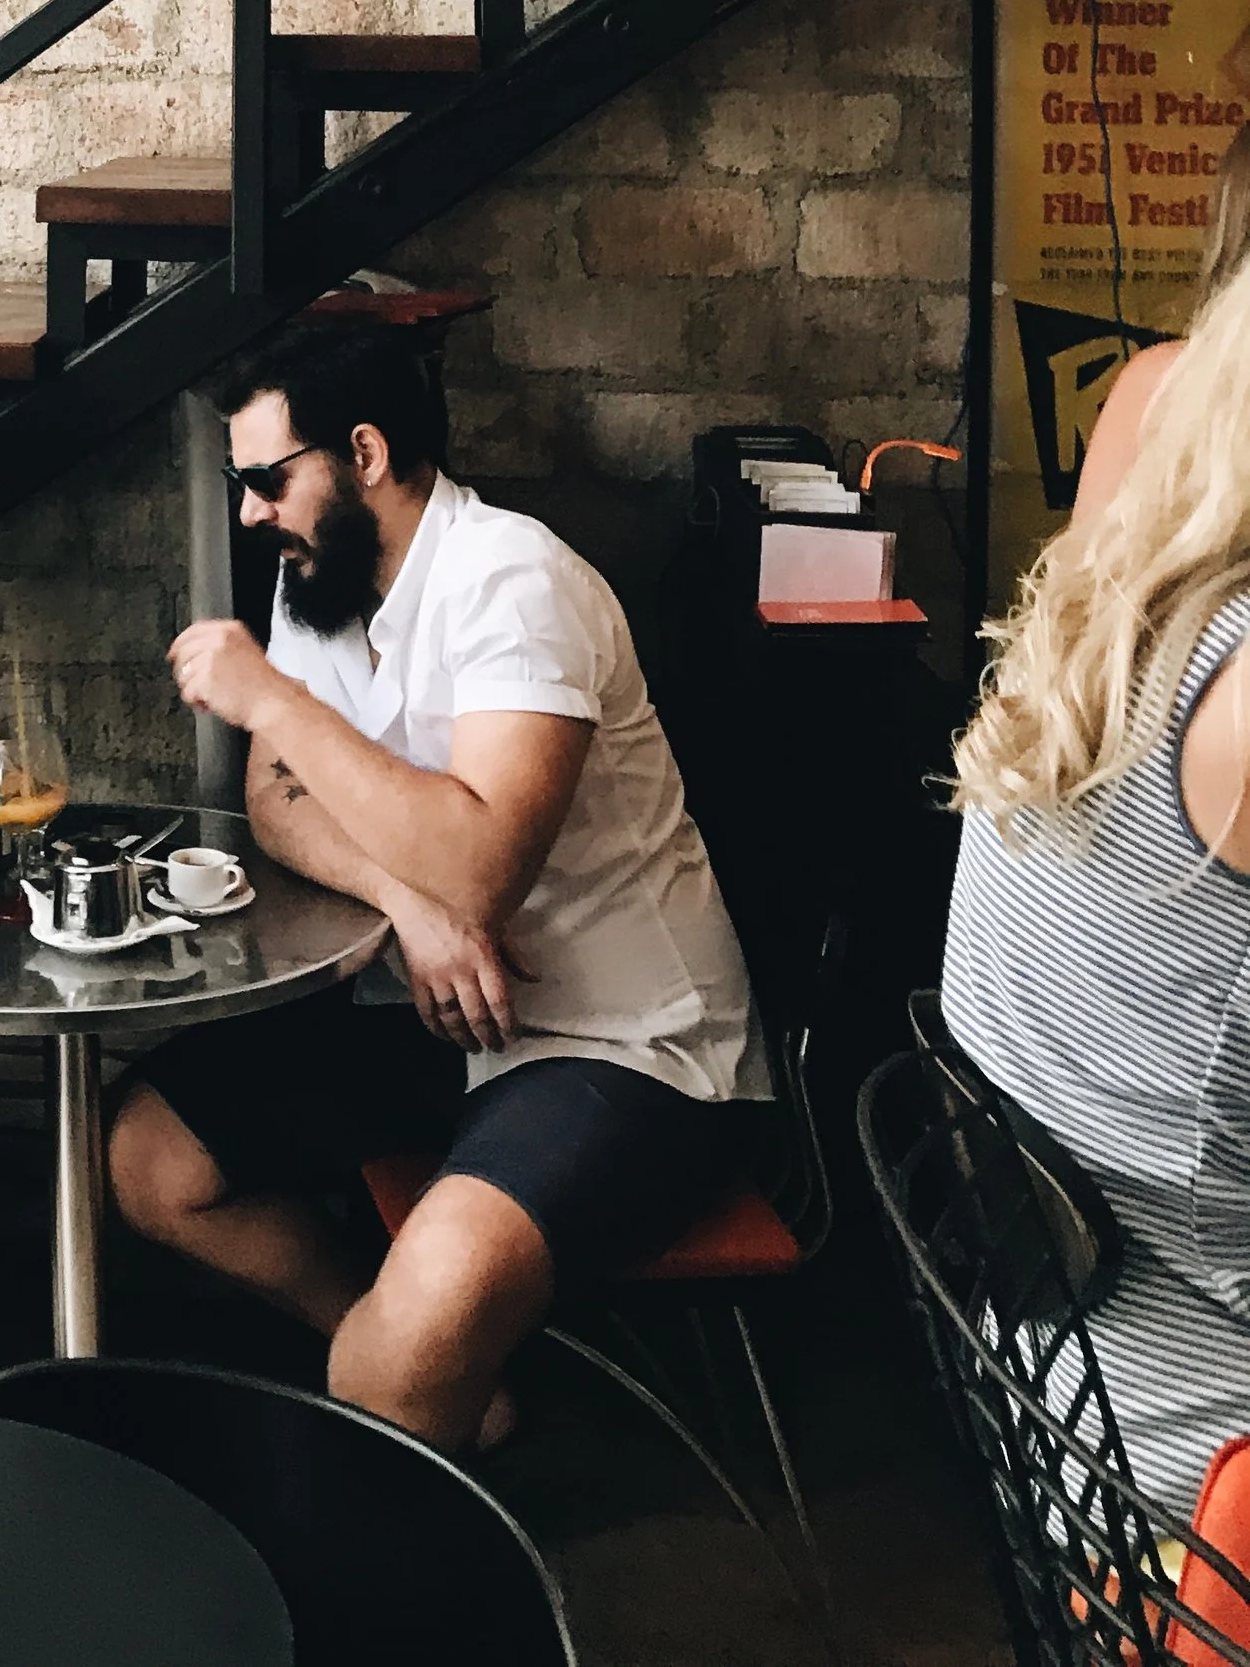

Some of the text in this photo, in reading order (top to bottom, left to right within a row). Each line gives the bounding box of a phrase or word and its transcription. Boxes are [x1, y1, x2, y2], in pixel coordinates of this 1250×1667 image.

[1043, 42, 1156, 76] Of The
[1042, 91, 1143, 125] Grand
[1124, 142, 1218, 176] Venic
[1043, 192, 1209, 227] Film Festi
